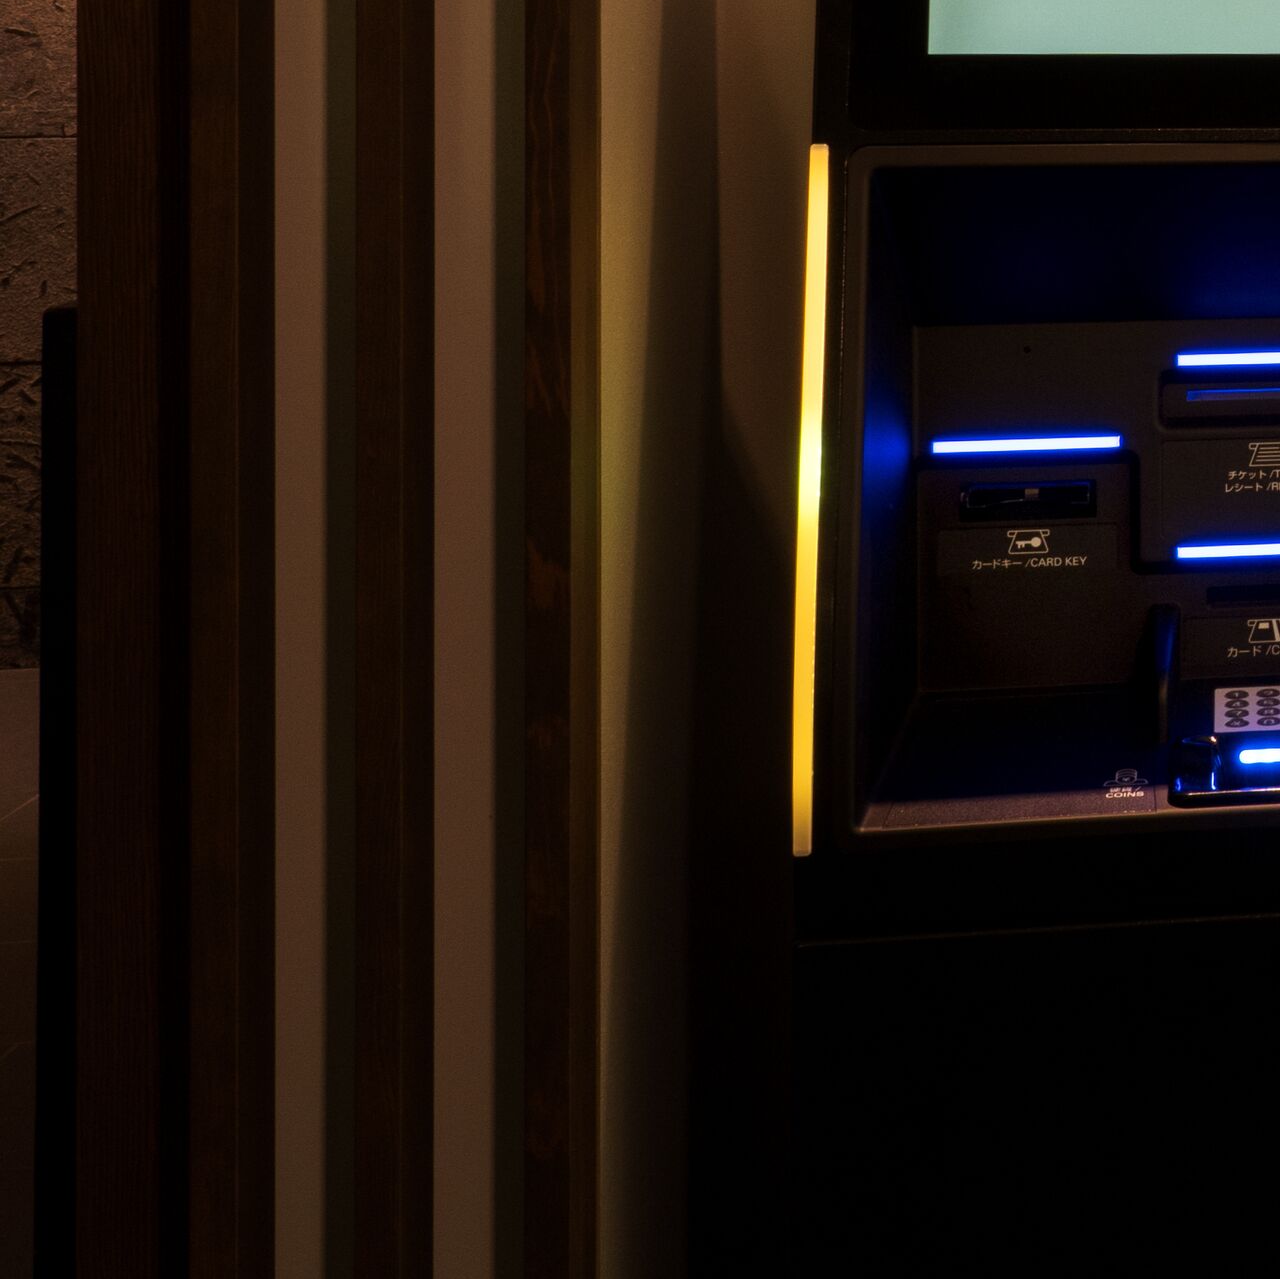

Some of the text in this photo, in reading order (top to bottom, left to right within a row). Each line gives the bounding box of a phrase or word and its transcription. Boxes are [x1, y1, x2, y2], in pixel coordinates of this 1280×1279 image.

[1228, 470, 1267, 480] チケット
[1225, 482, 1263, 493] レシート
[972, 558, 1022, 570] カードキー
[1065, 556, 1087, 566] KEY
[1227, 645, 1262, 658] カード
